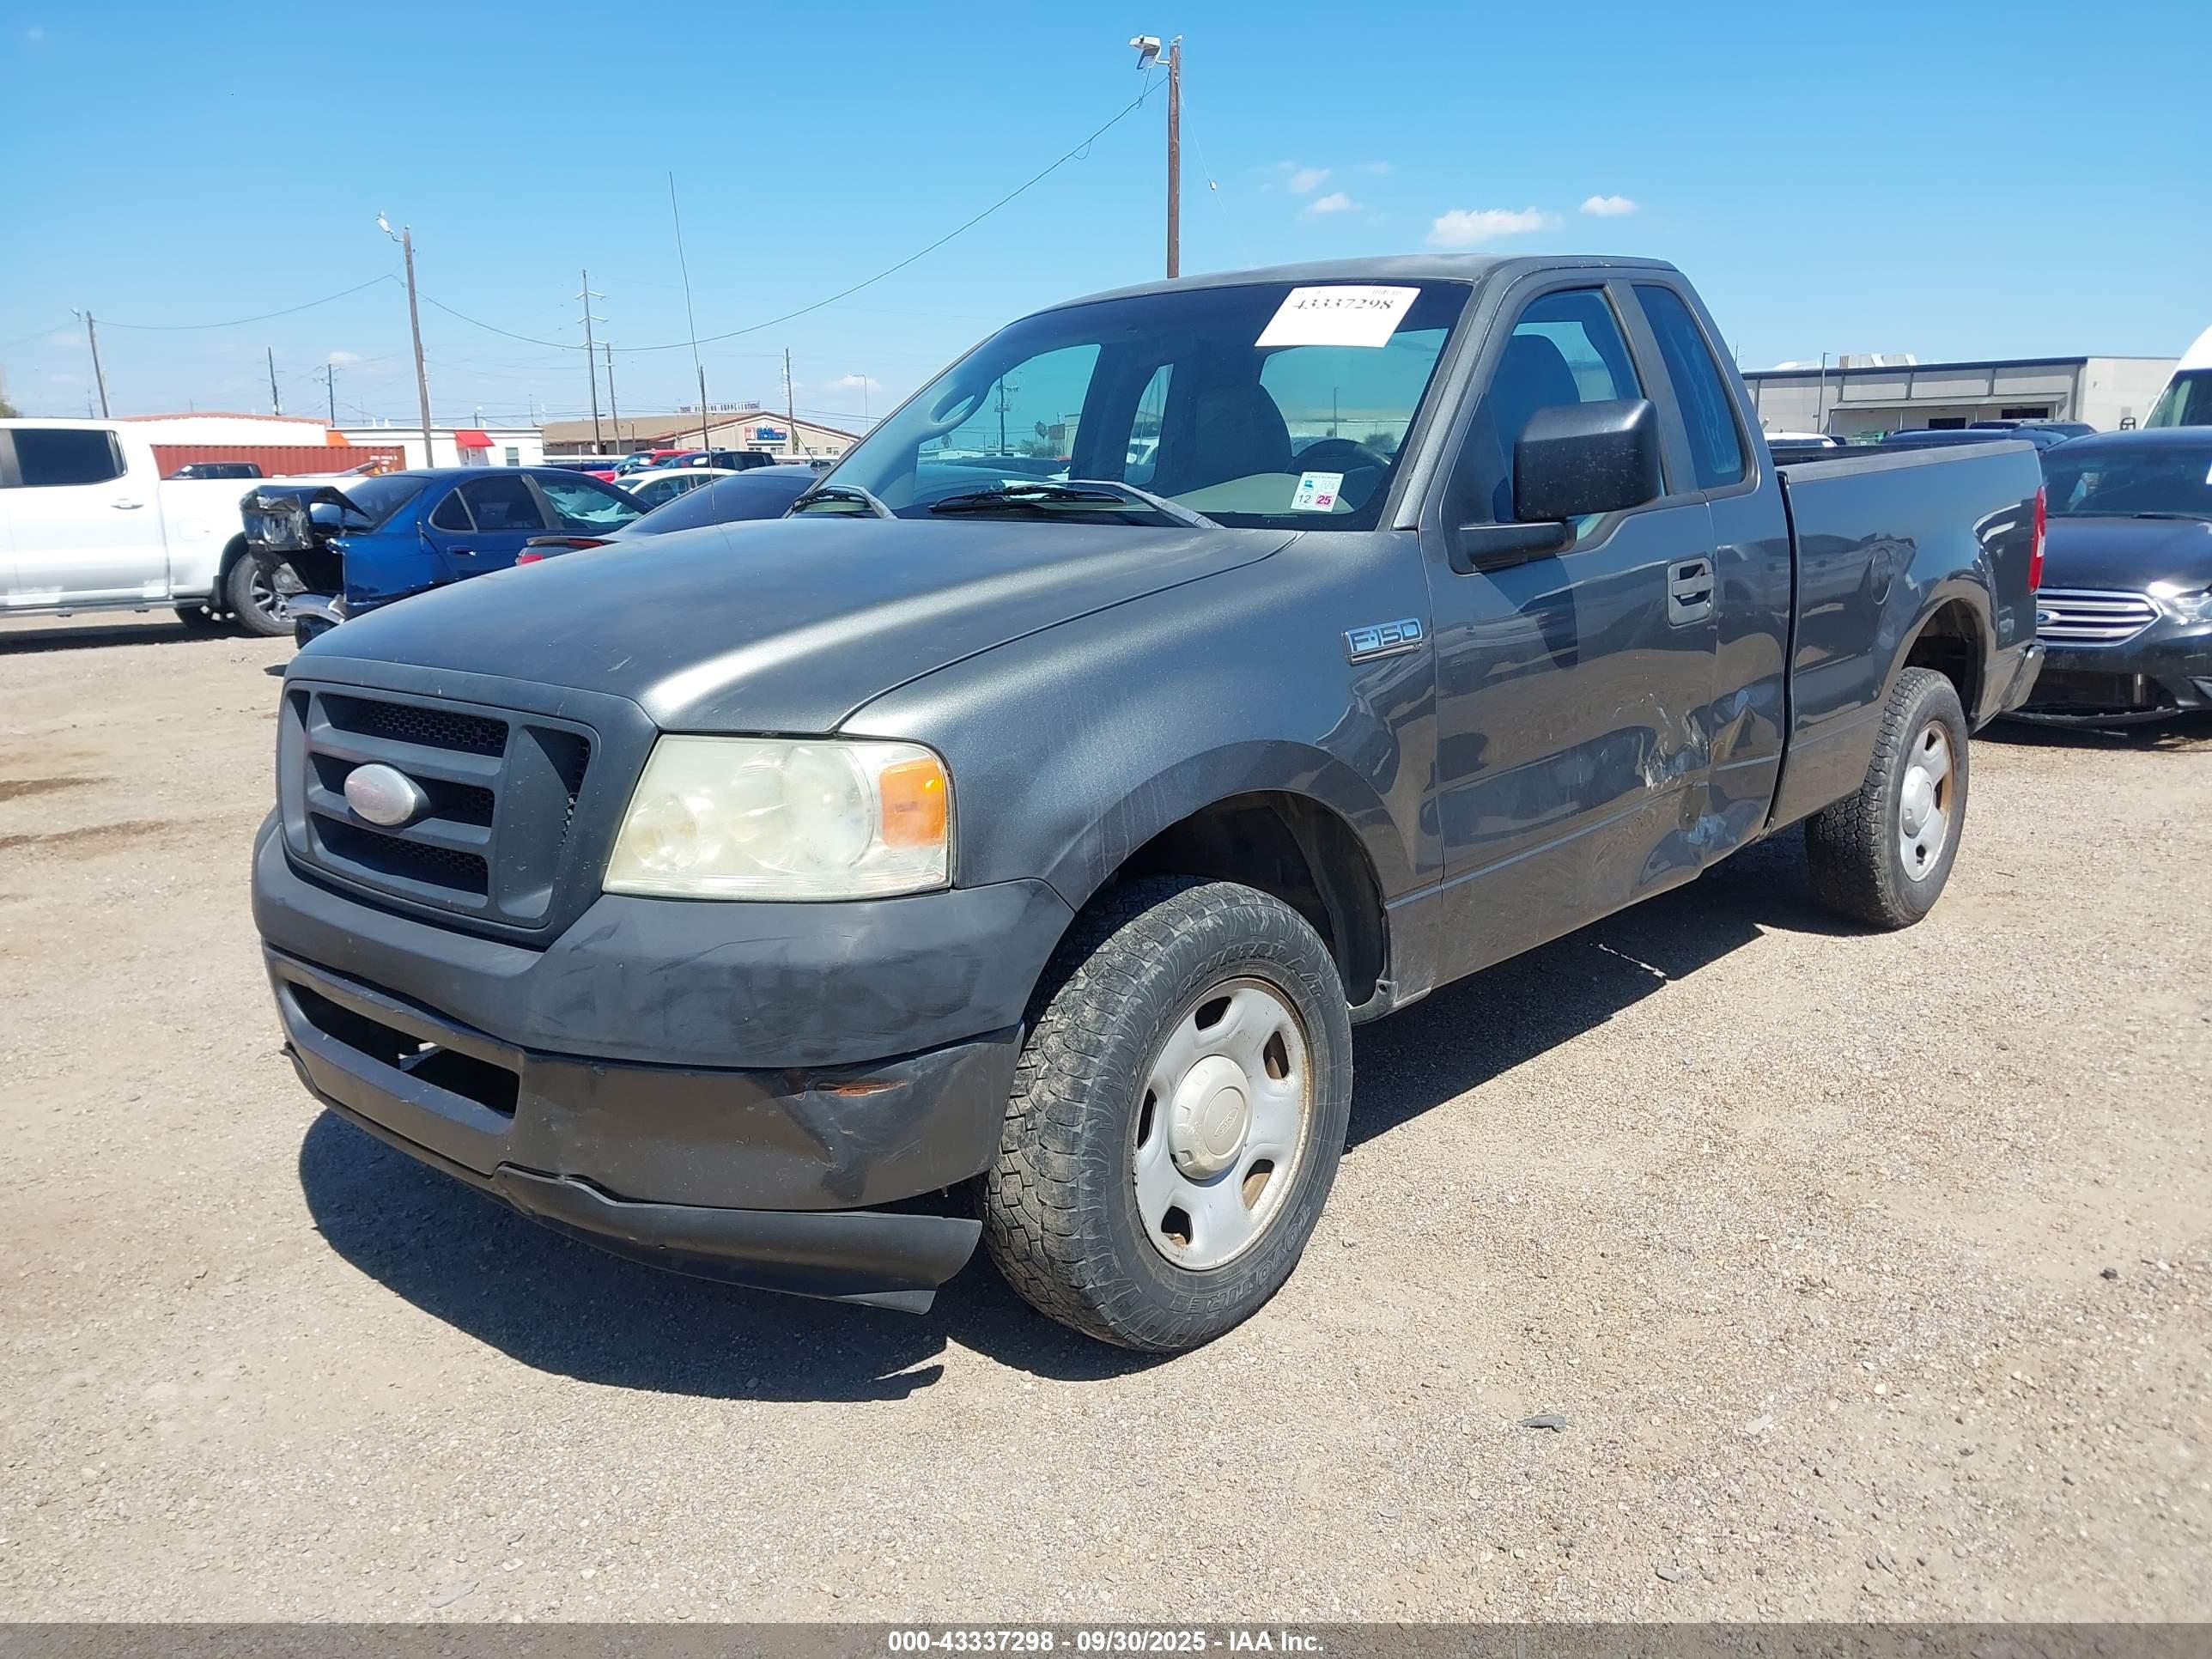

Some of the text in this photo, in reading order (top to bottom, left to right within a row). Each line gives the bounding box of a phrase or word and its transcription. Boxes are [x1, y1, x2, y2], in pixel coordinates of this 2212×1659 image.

[1291, 298, 1394, 310] 43337298
[1298, 495, 1332, 505] 12 25
[1349, 620, 1422, 653] F-150
[1168, 1205, 1312, 1315] TOYO TIRES
